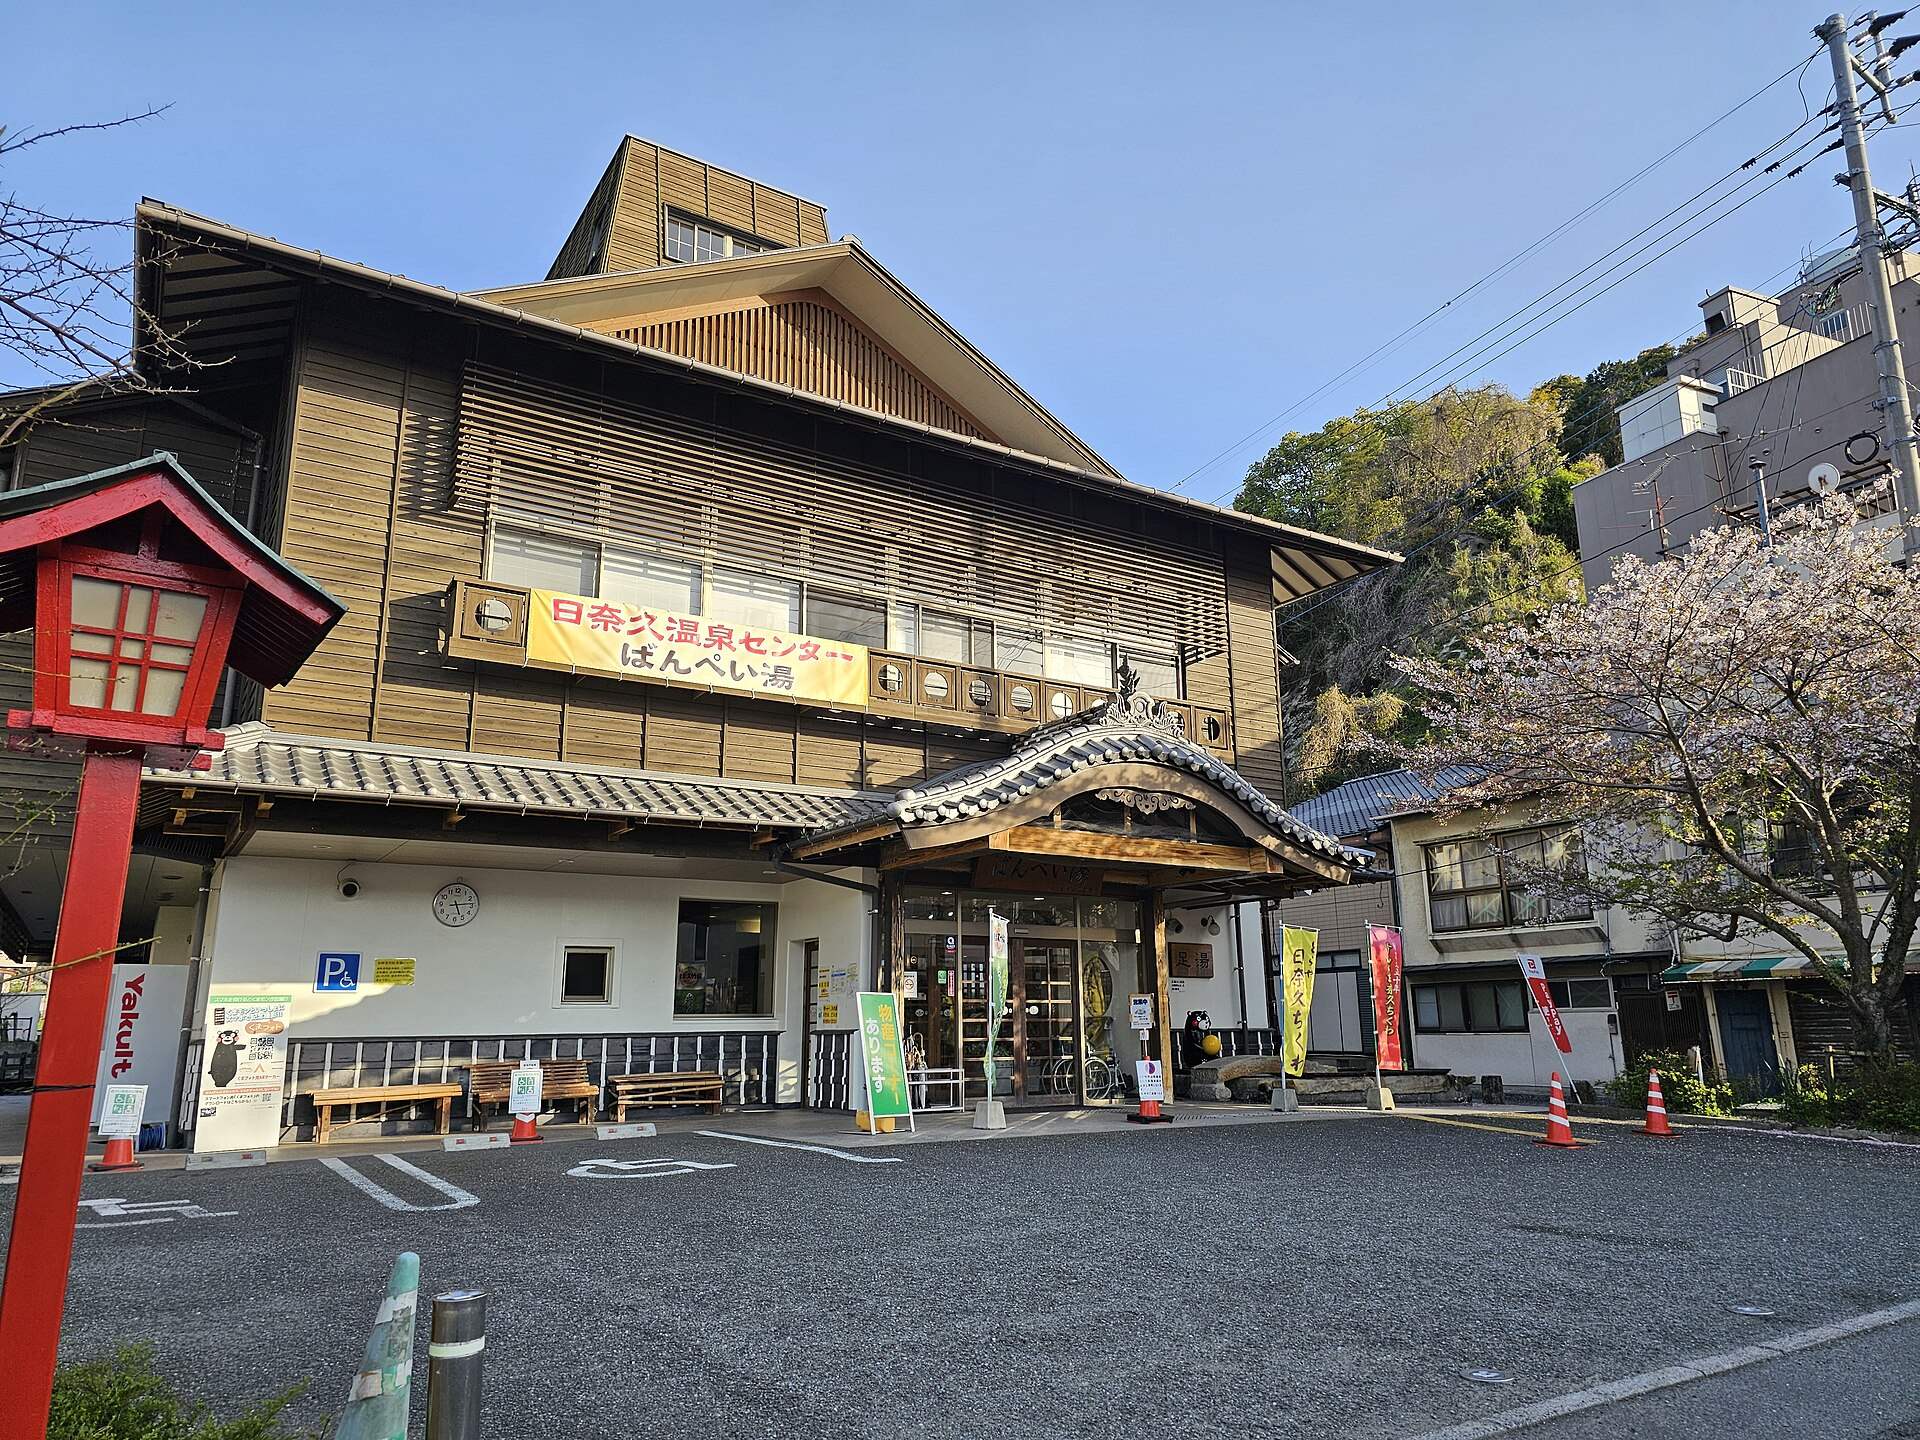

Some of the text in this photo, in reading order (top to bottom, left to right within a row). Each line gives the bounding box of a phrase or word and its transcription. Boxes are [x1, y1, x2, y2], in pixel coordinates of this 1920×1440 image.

[552, 598, 854, 662] 日奈久温泉センター
[621, 642, 795, 691] ばんぺい湯
[323, 957, 346, 987] P
[1175, 951, 1210, 969] 足湯
[111, 972, 146, 1079] Yakult
[1290, 949, 1306, 1072] 日奈久ちくわ
[865, 1017, 886, 1094] あります
